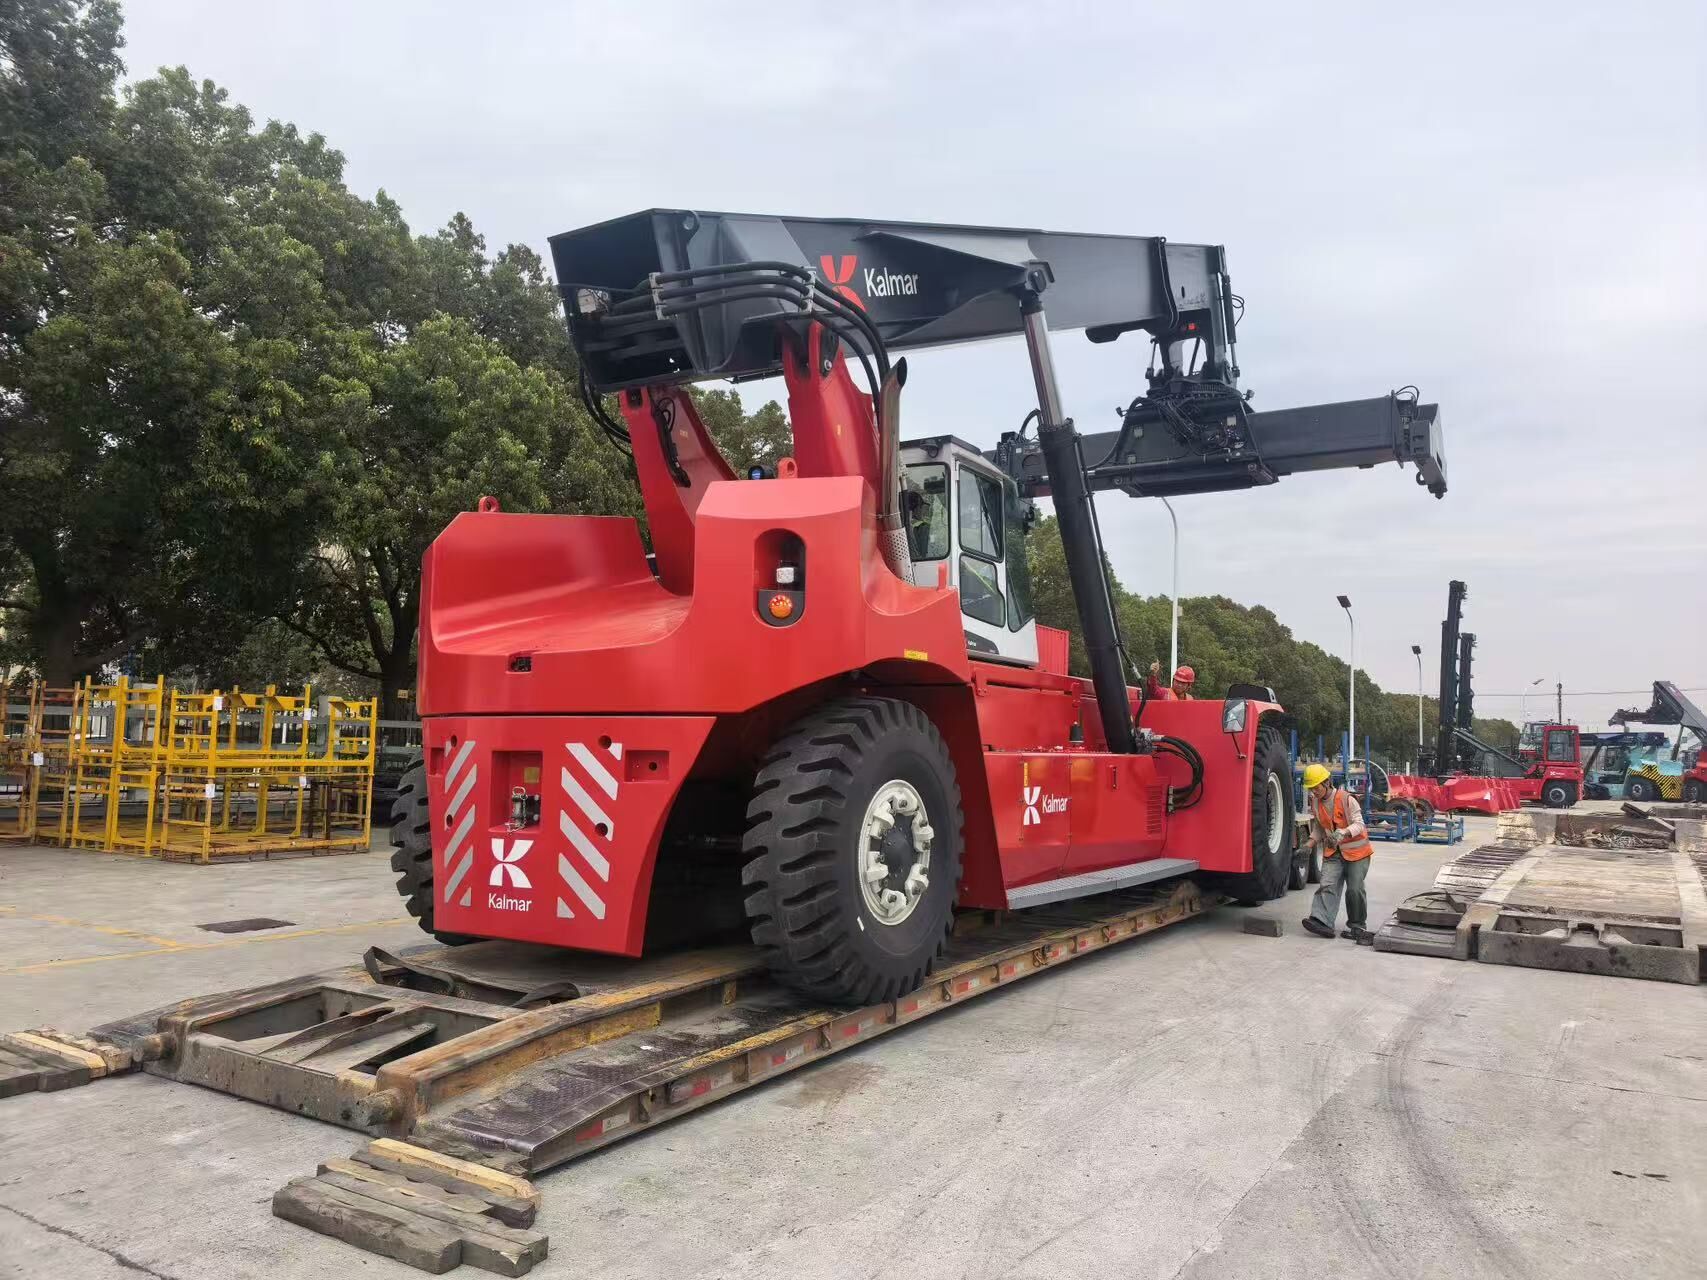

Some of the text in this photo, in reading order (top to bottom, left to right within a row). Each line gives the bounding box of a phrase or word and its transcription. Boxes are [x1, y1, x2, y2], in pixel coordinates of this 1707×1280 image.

[864, 267, 918, 297] Kalmar
[1042, 794, 1068, 814] Kalmar
[488, 893, 532, 912] Kalmar
